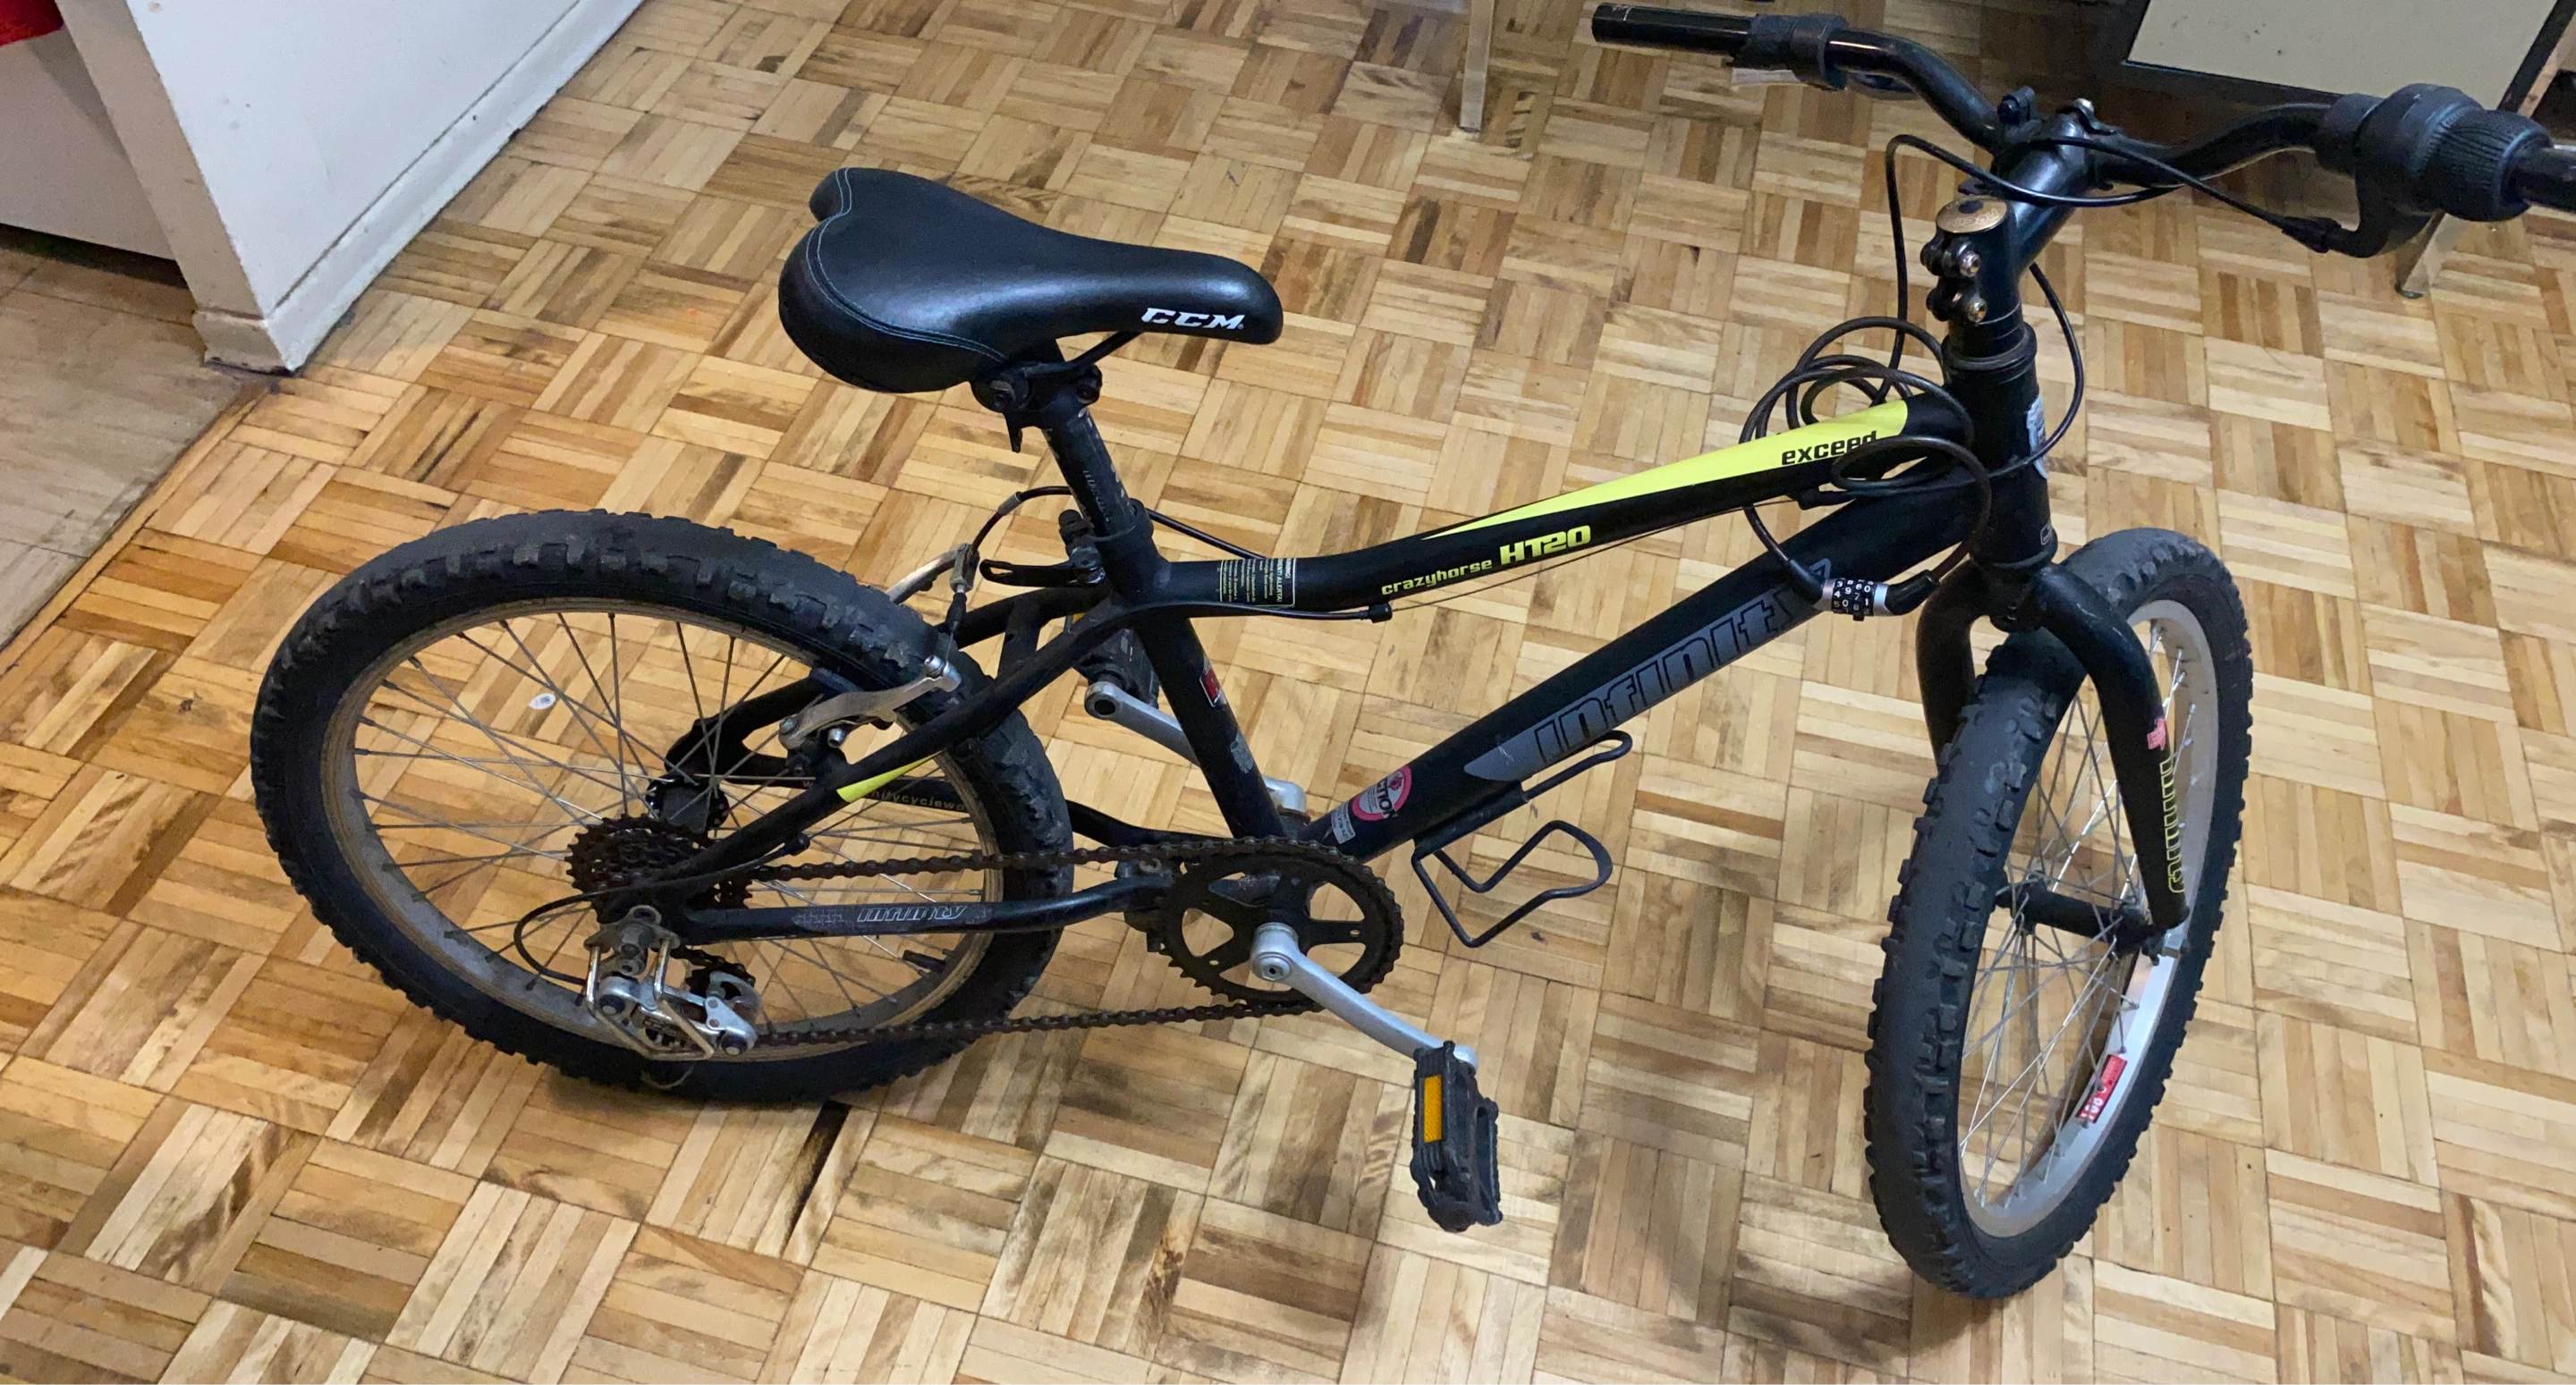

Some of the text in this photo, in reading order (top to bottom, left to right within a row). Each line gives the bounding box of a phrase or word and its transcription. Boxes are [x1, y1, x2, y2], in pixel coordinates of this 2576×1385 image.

[1141, 308, 1245, 330] CCM
[1782, 430, 1877, 466] exceed
[1381, 524, 1591, 596] crazyhorse HT20
[1534, 562, 1828, 765] infinit
